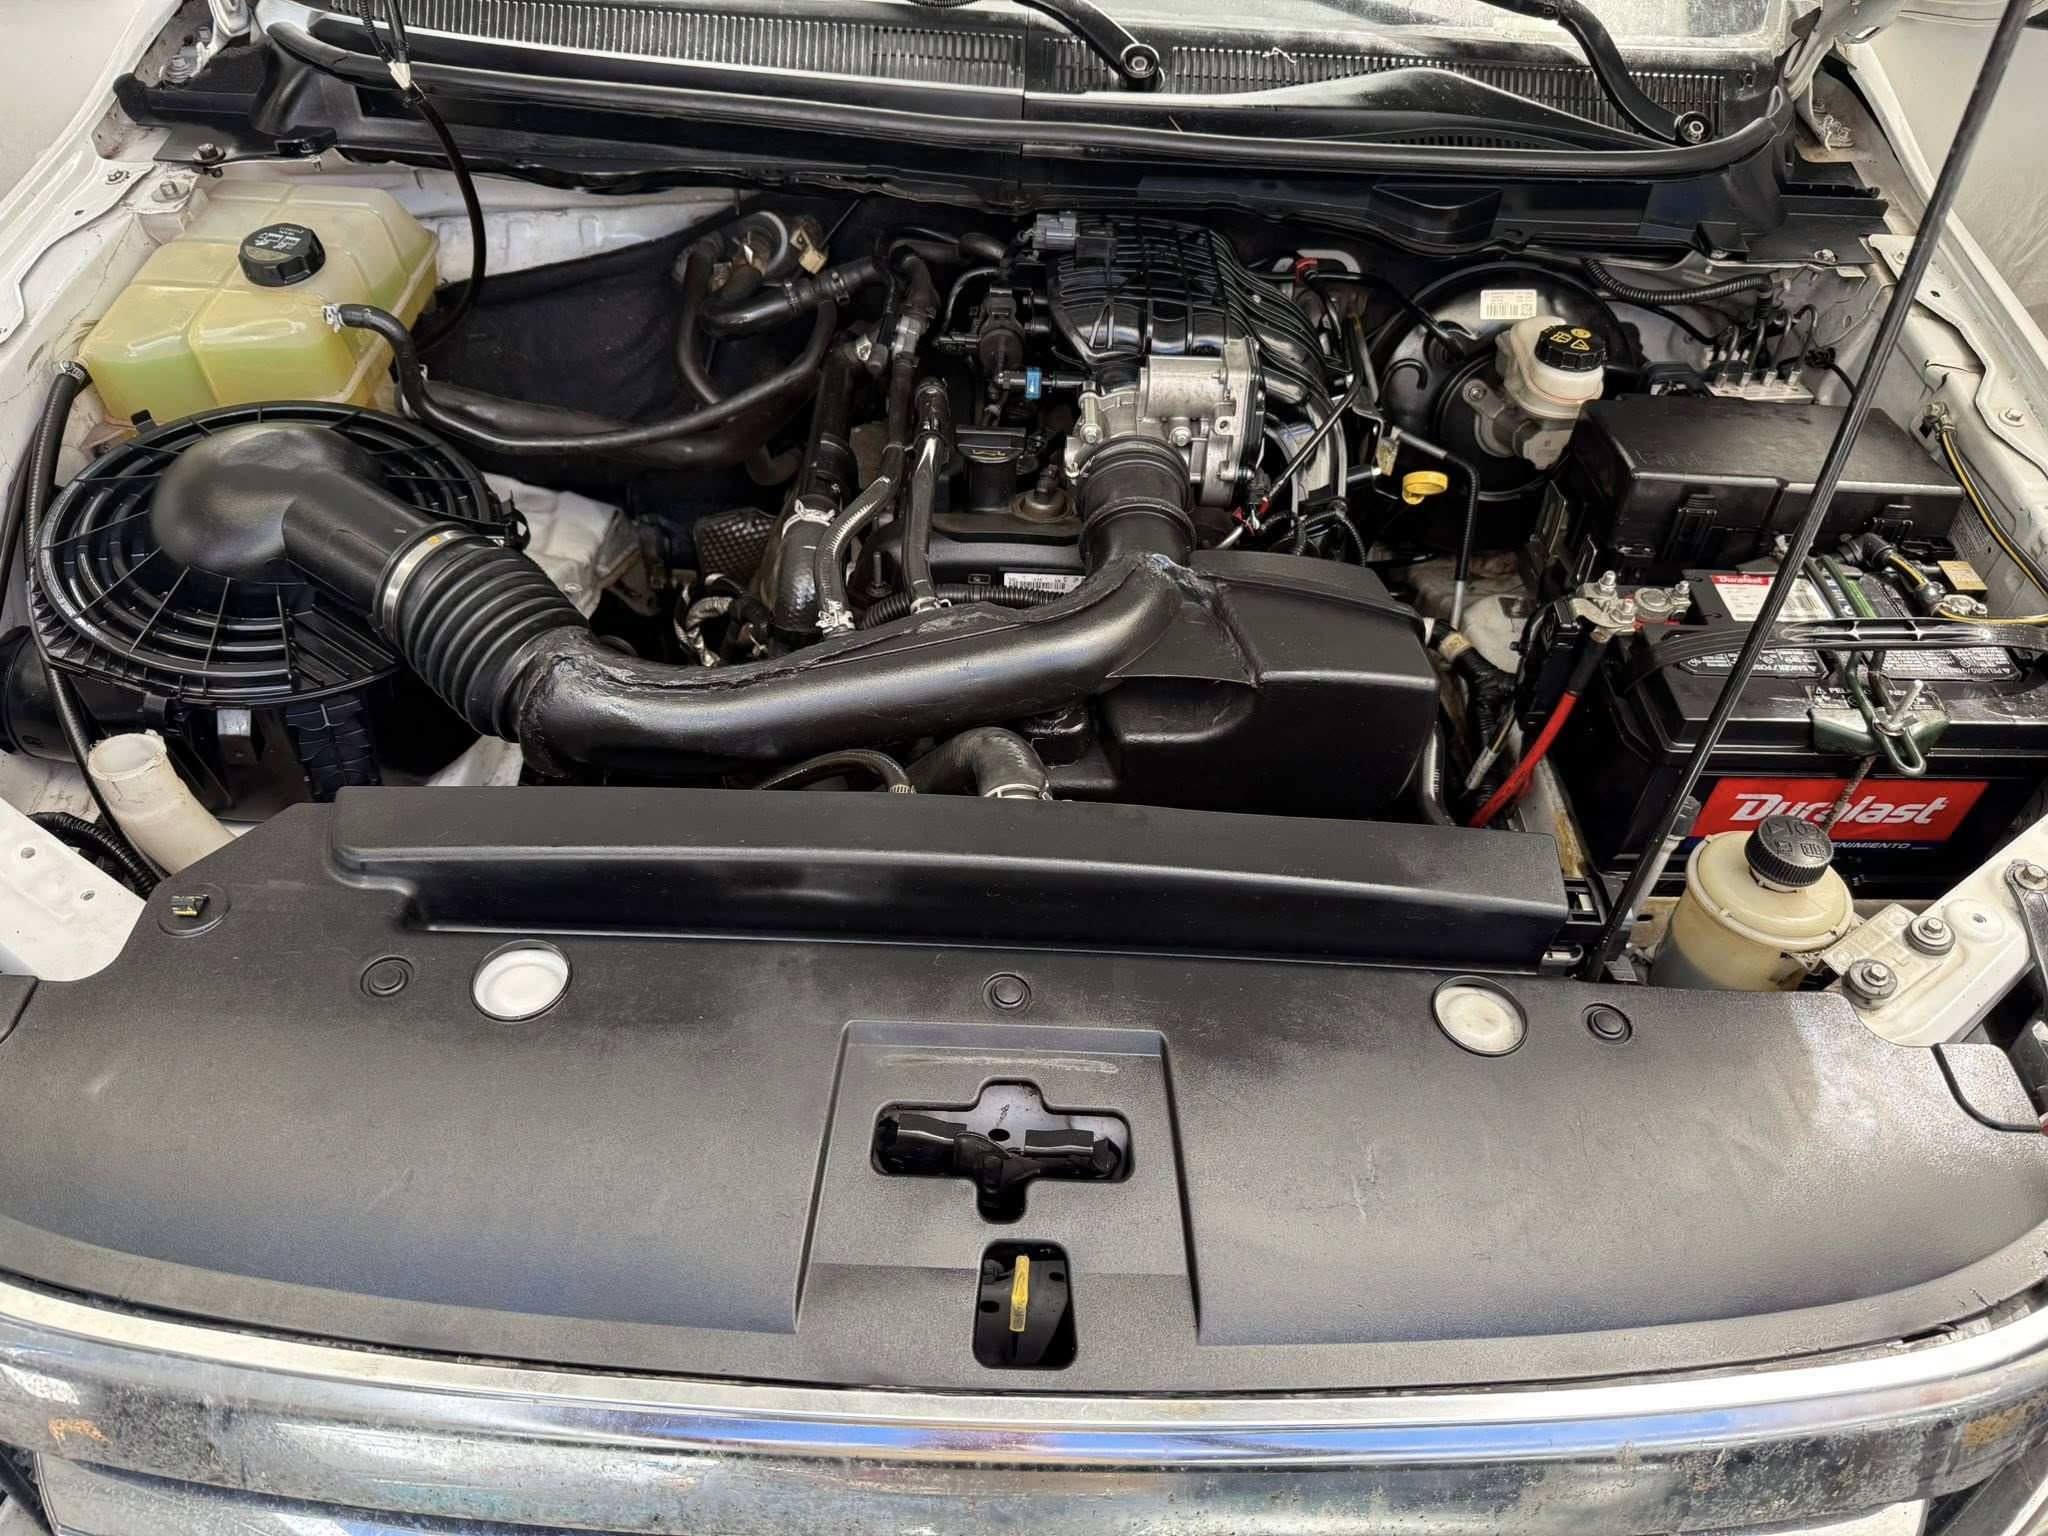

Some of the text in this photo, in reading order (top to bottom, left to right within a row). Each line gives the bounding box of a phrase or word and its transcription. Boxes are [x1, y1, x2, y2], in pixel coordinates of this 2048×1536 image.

[1719, 575, 1763, 584] Duralast
[1728, 793, 1950, 825] Duralast
[1832, 841, 1911, 850] ENIMIENTO
